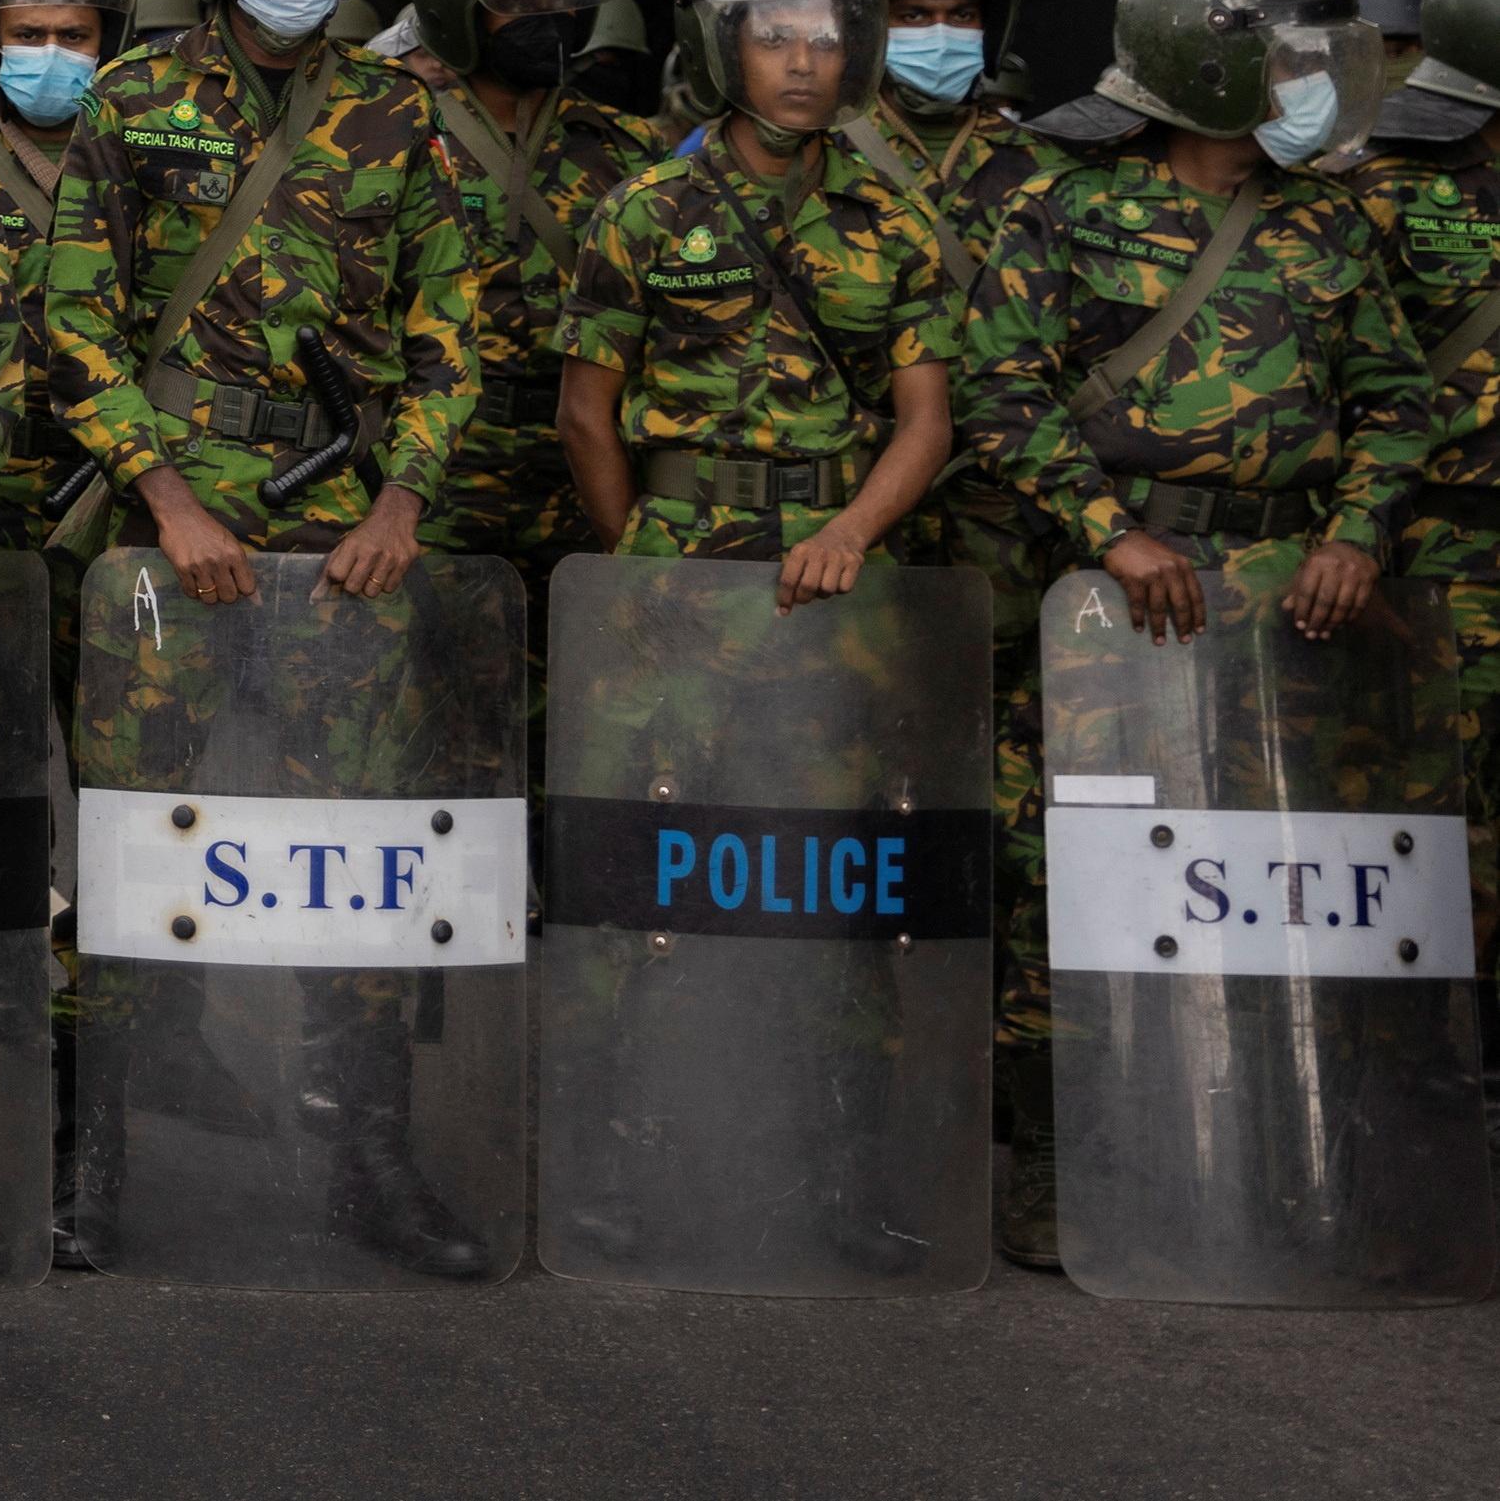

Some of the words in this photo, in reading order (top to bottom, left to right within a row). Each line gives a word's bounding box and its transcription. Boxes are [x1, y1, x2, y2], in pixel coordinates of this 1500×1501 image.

[124, 130, 167, 147] SPECIAL
[168, 133, 197, 150] TASK
[198, 139, 235, 155] FORCE
[1071, 226, 1117, 249] SPECIAL
[1119, 240, 1149, 257] TASK
[1151, 248, 1188, 266] FORCE
[646, 272, 686, 288] SPECIAL
[686, 273, 716, 287] TASK
[717, 267, 753, 284] FORCE
[132, 566, 162, 651] A
[1075, 587, 1113, 633] A
[204, 840, 424, 911] S.T.F
[657, 829, 905, 915] POLICE
[1185, 858, 1390, 928] S.T.F
